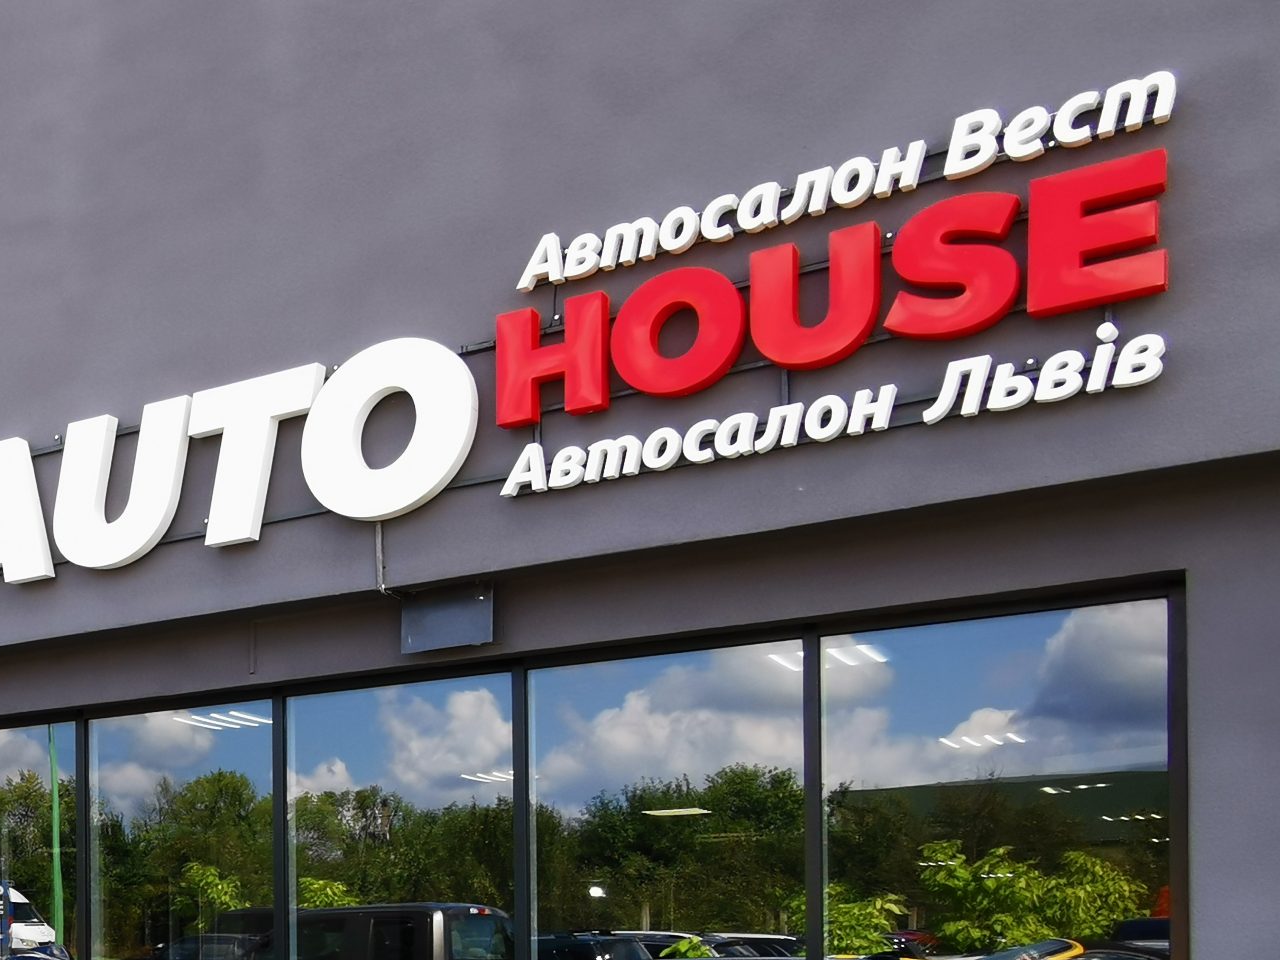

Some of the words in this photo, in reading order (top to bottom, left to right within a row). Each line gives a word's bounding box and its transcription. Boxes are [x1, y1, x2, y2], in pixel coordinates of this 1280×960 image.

[495, 147, 1169, 430] HOUSE
[516, 138, 926, 292] Автосалон
[943, 70, 1177, 180] Вест
[500, 383, 898, 498] Автосалон
[922, 321, 1167, 425] Львів
